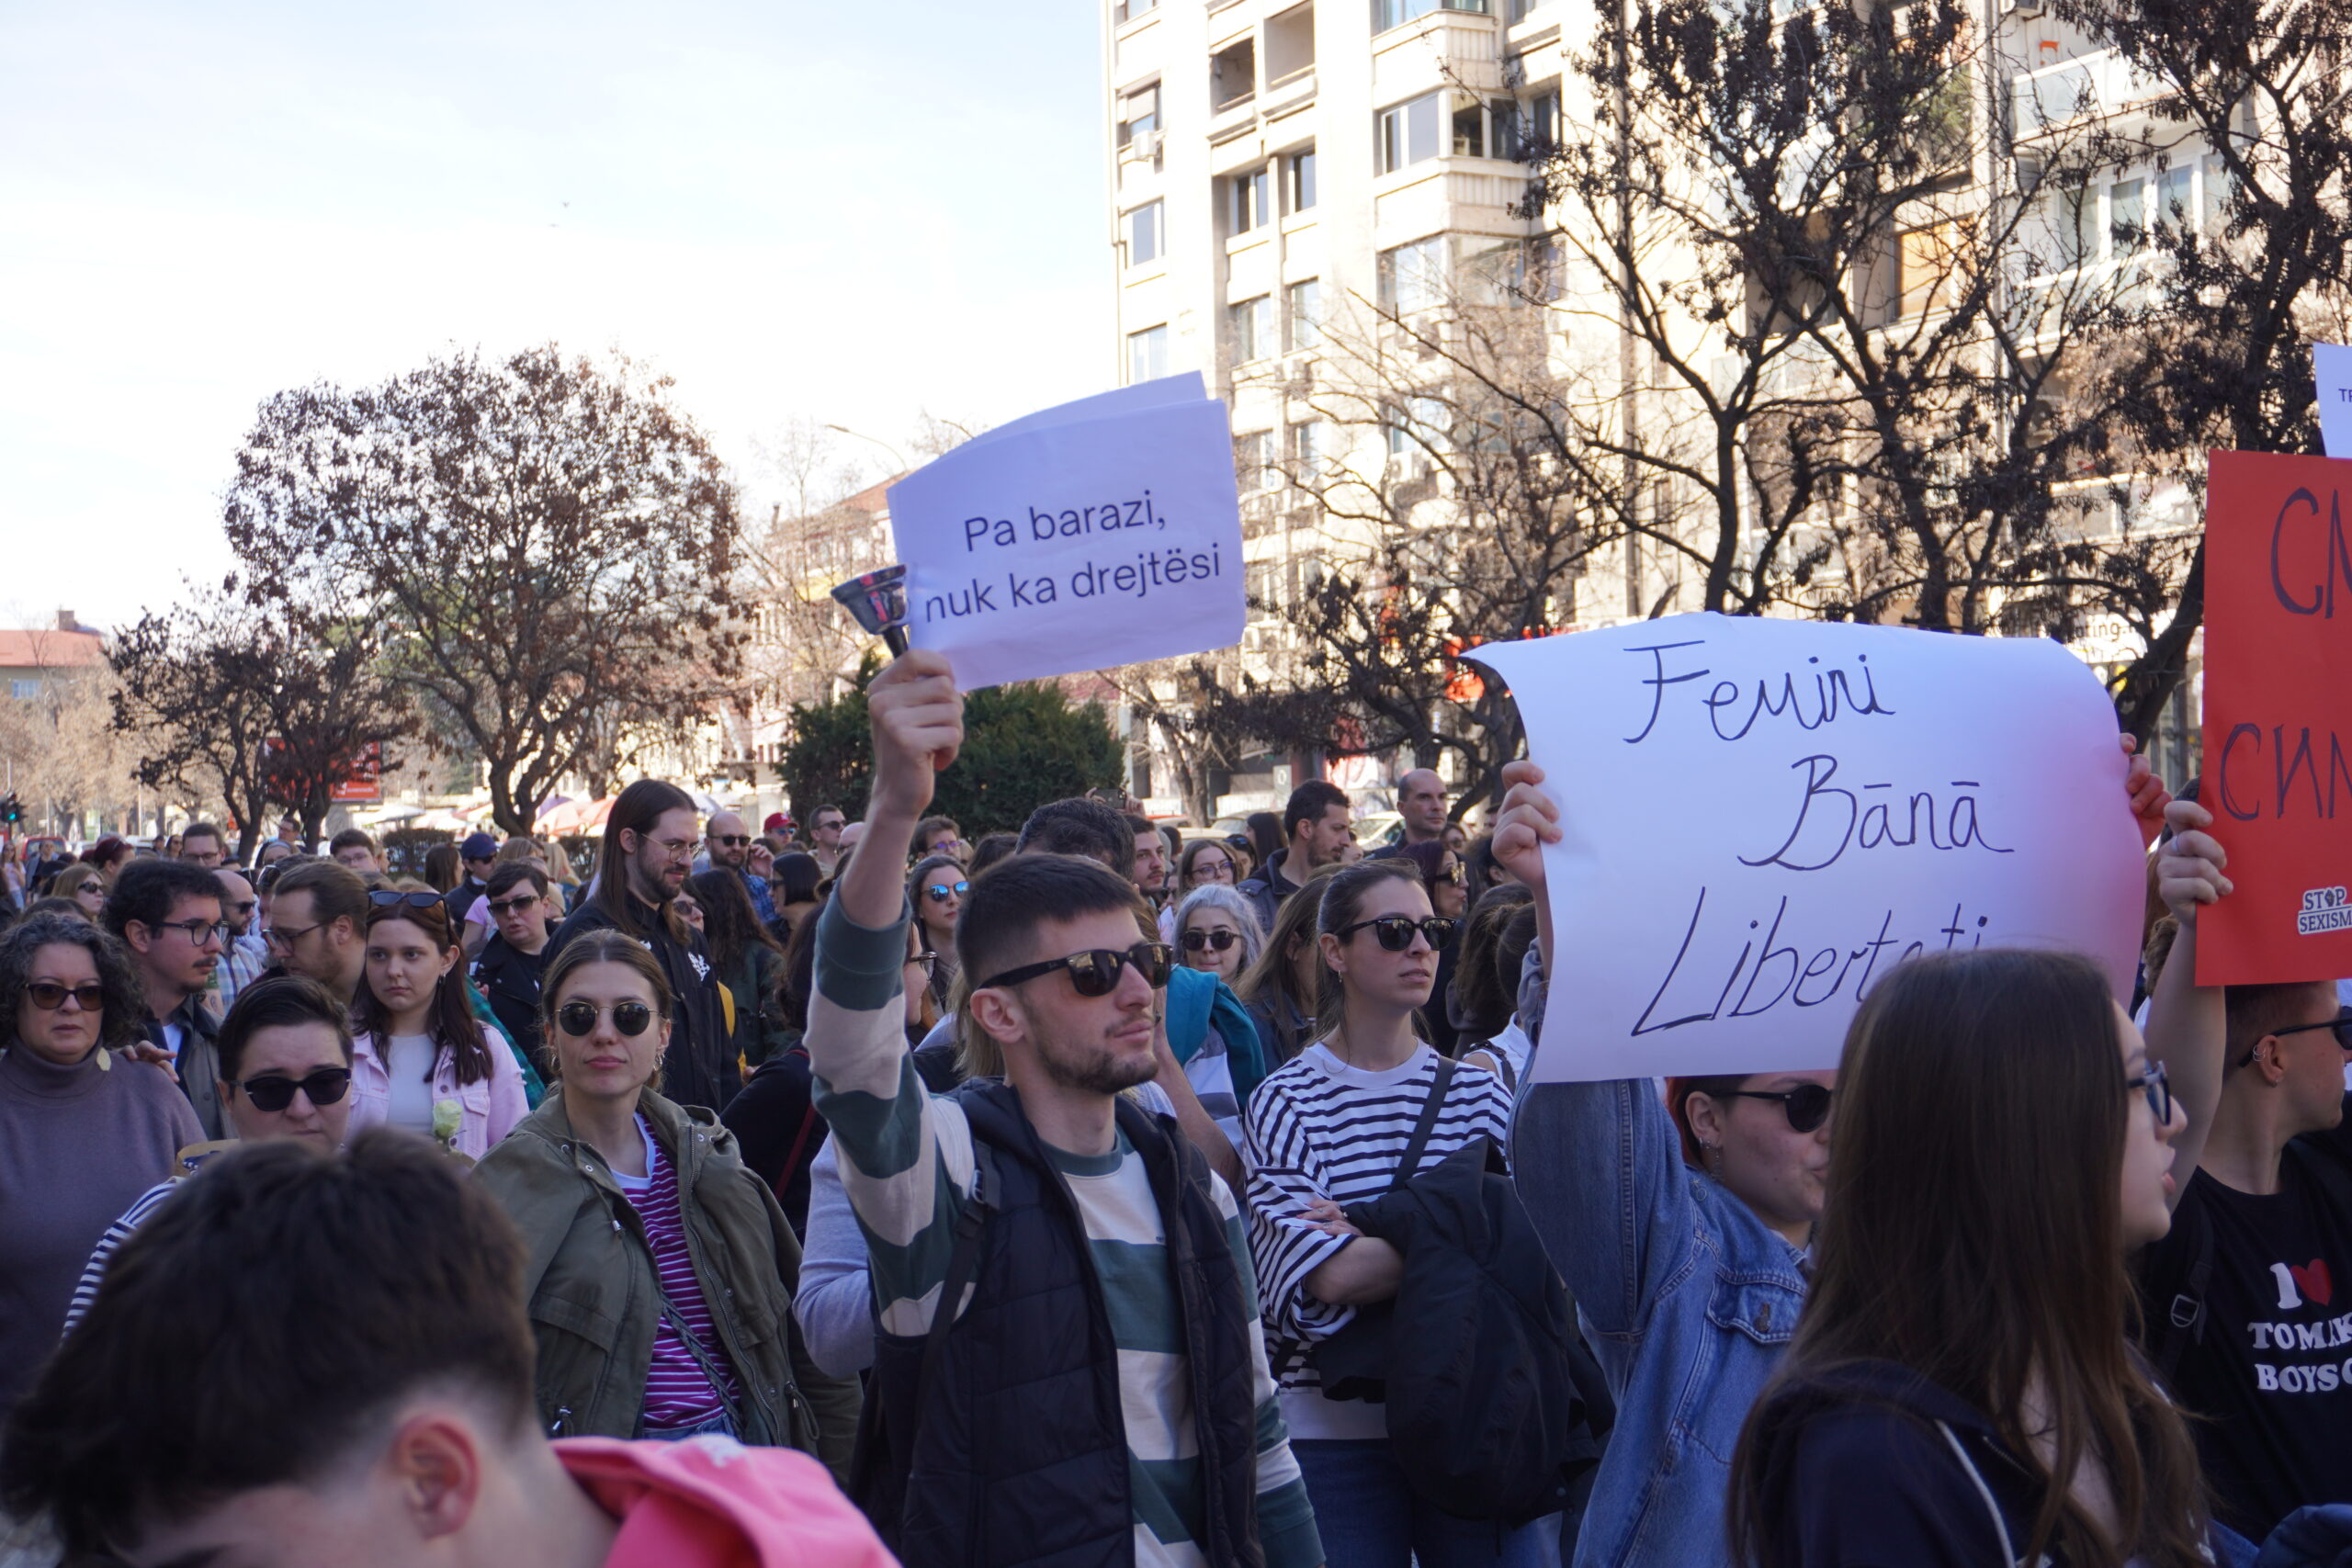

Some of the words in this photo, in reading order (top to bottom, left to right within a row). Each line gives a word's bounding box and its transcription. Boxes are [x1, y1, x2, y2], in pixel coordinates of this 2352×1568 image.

[965, 516, 1016, 552] Pa
[1029, 490, 1166, 540] barazi,
[924, 579, 997, 623] nuk
[1009, 572, 1057, 608] ka
[1071, 542, 1220, 598] drejtësi
[2299, 909, 2352, 932] SEXISM
[2269, 1262, 2302, 1310] I
[2254, 1363, 2339, 1393] BOYS
